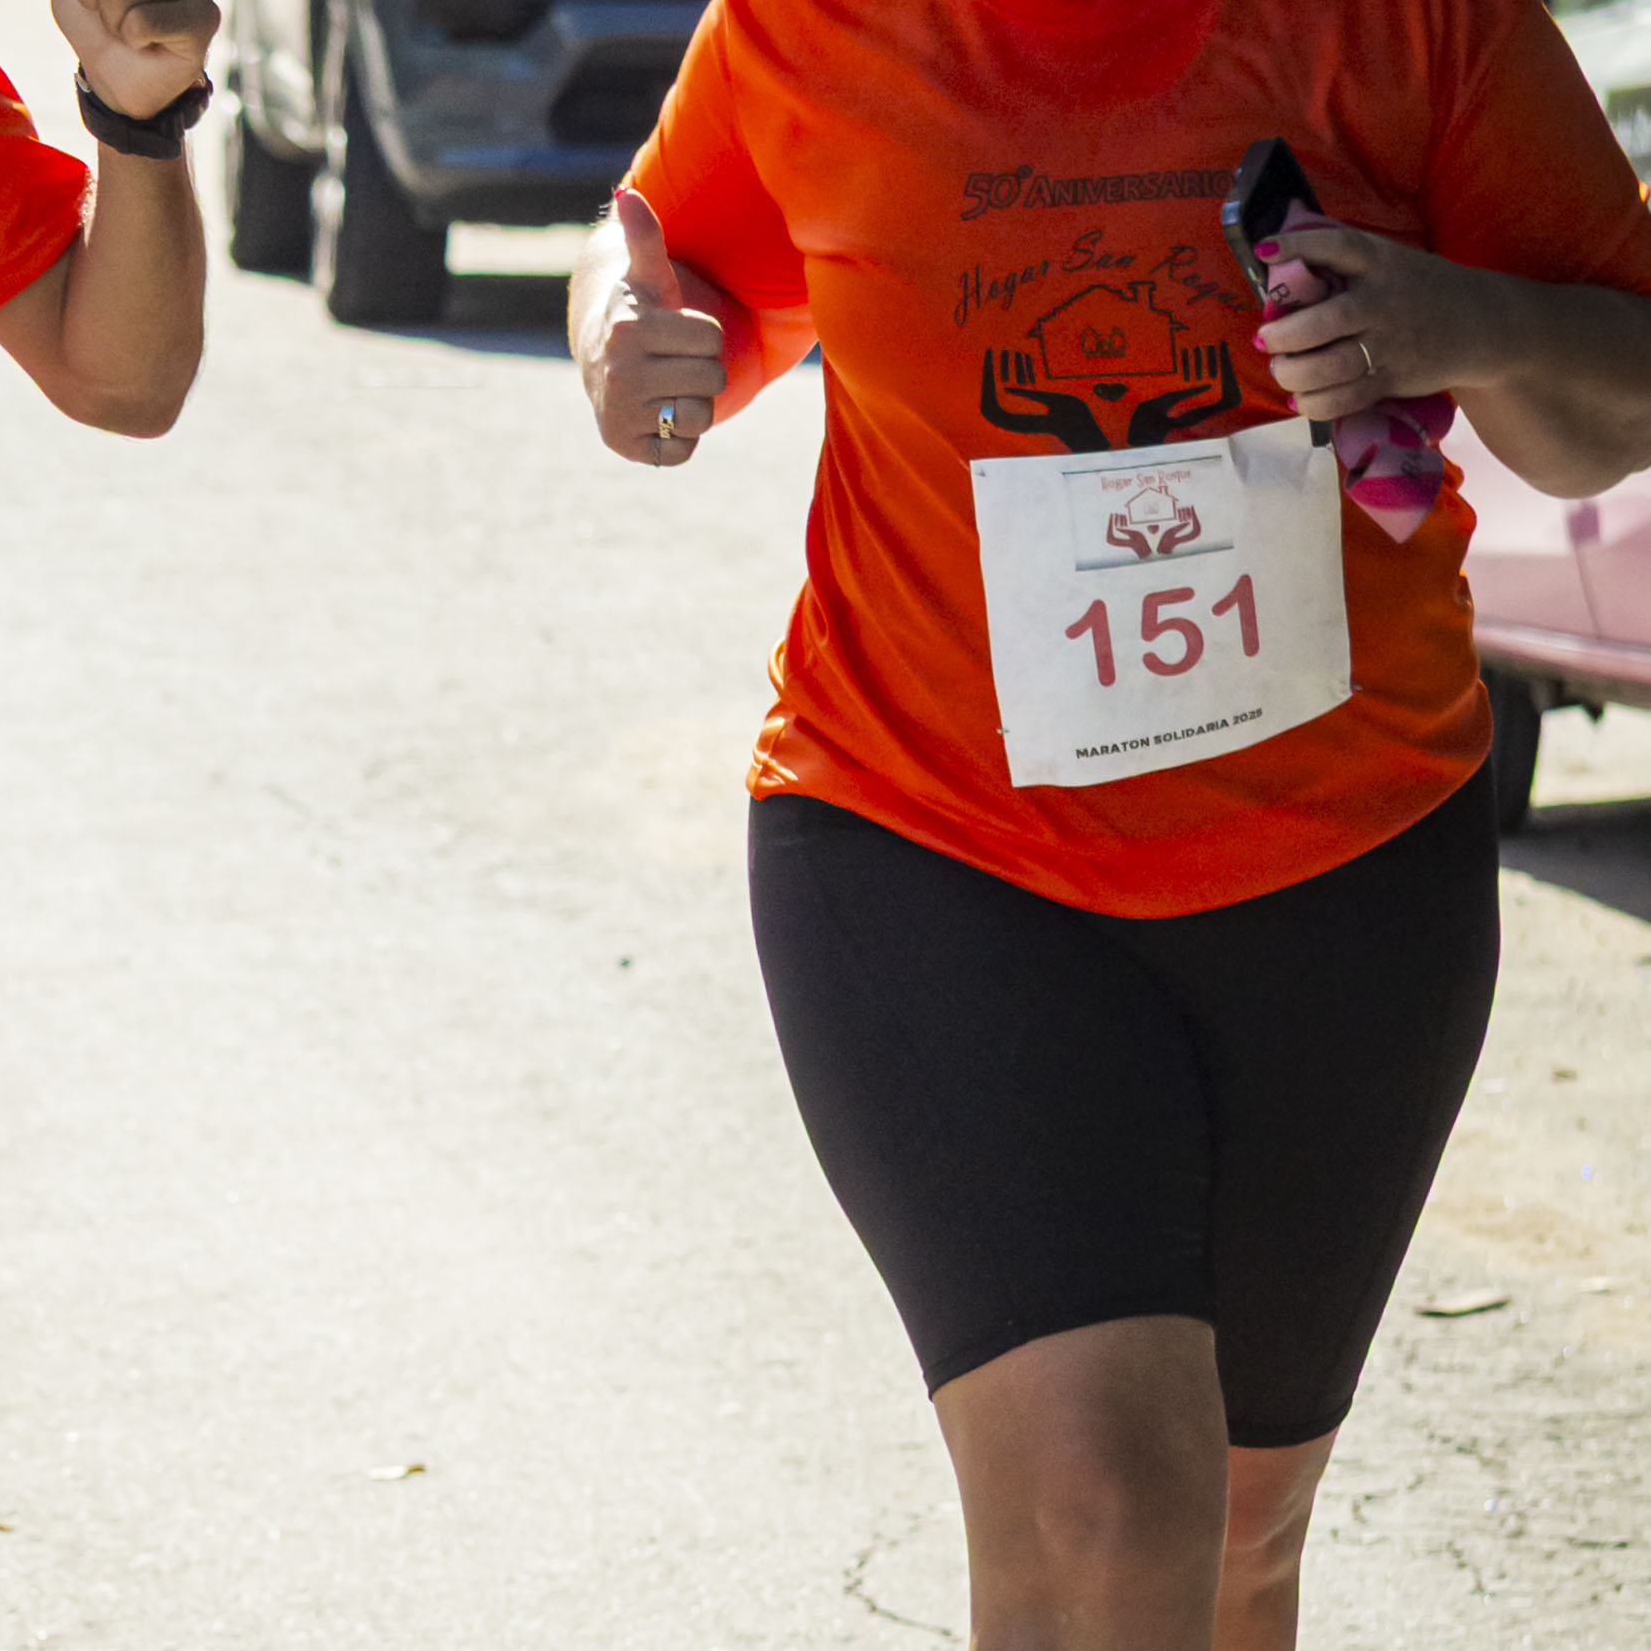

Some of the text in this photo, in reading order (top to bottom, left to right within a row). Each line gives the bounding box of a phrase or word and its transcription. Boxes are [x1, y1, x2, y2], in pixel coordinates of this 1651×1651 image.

[954, 261, 1049, 326] Hogar
[1062, 229, 1135, 272] San
[1136, 472, 1156, 487] San
[1065, 573, 1260, 687] 151
[1076, 707, 1263, 759] MARATON SOLIDARIA 2025
